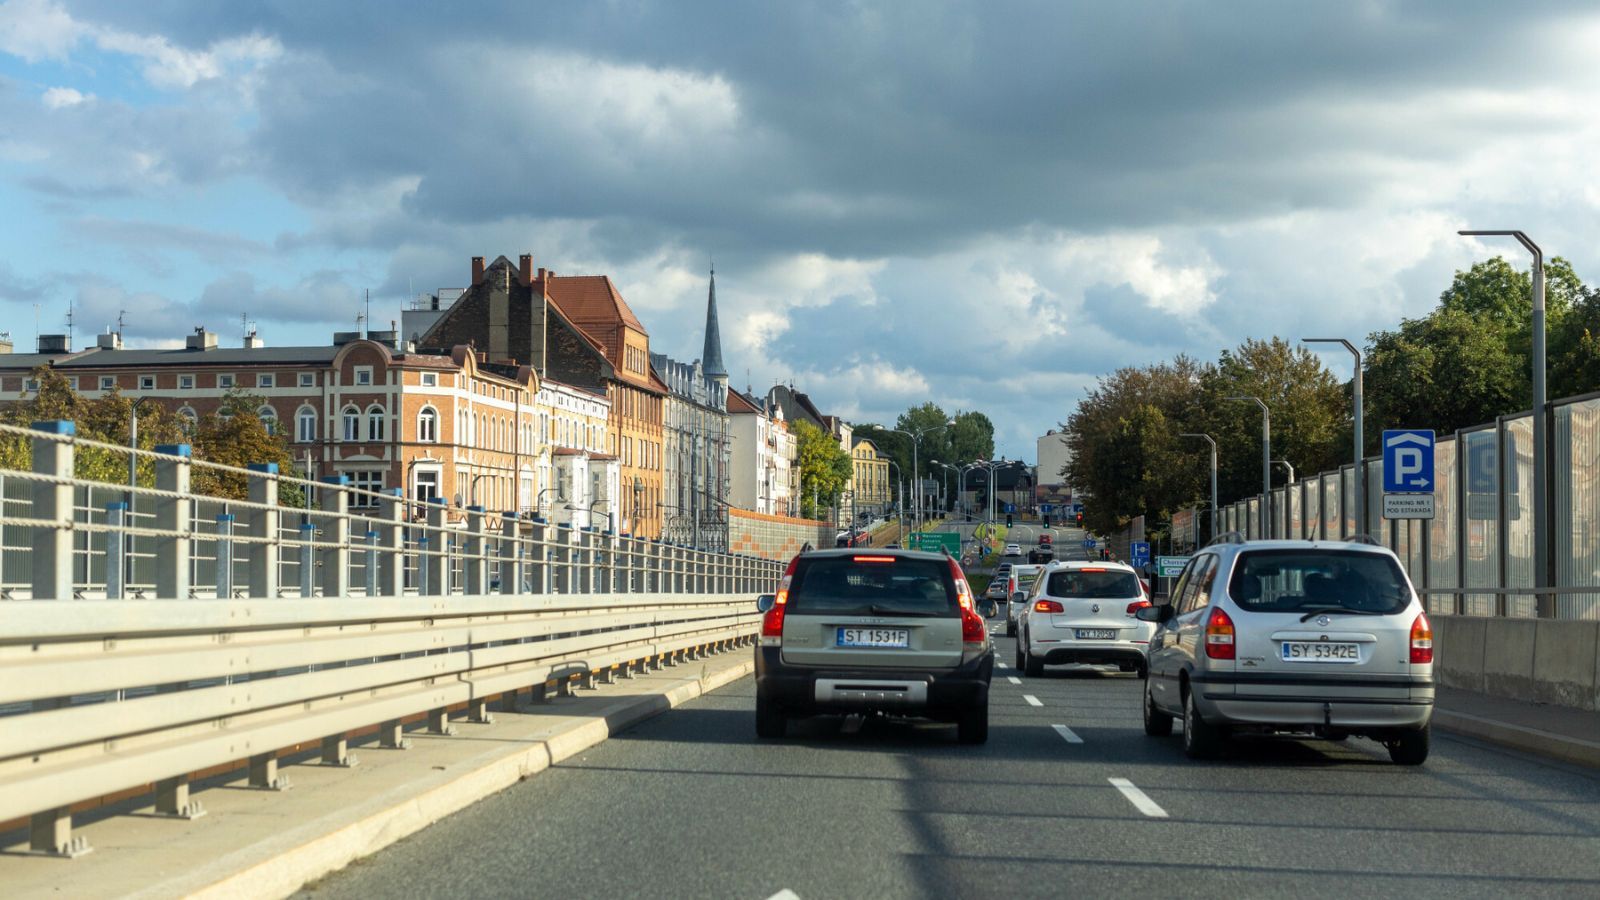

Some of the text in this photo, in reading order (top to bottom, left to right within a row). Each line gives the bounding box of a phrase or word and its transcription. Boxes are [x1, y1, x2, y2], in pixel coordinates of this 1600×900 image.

[1395, 447, 1423, 485] P
[845, 630, 906, 642] ST 1531F
[1291, 645, 1359, 659] SY 5342E
